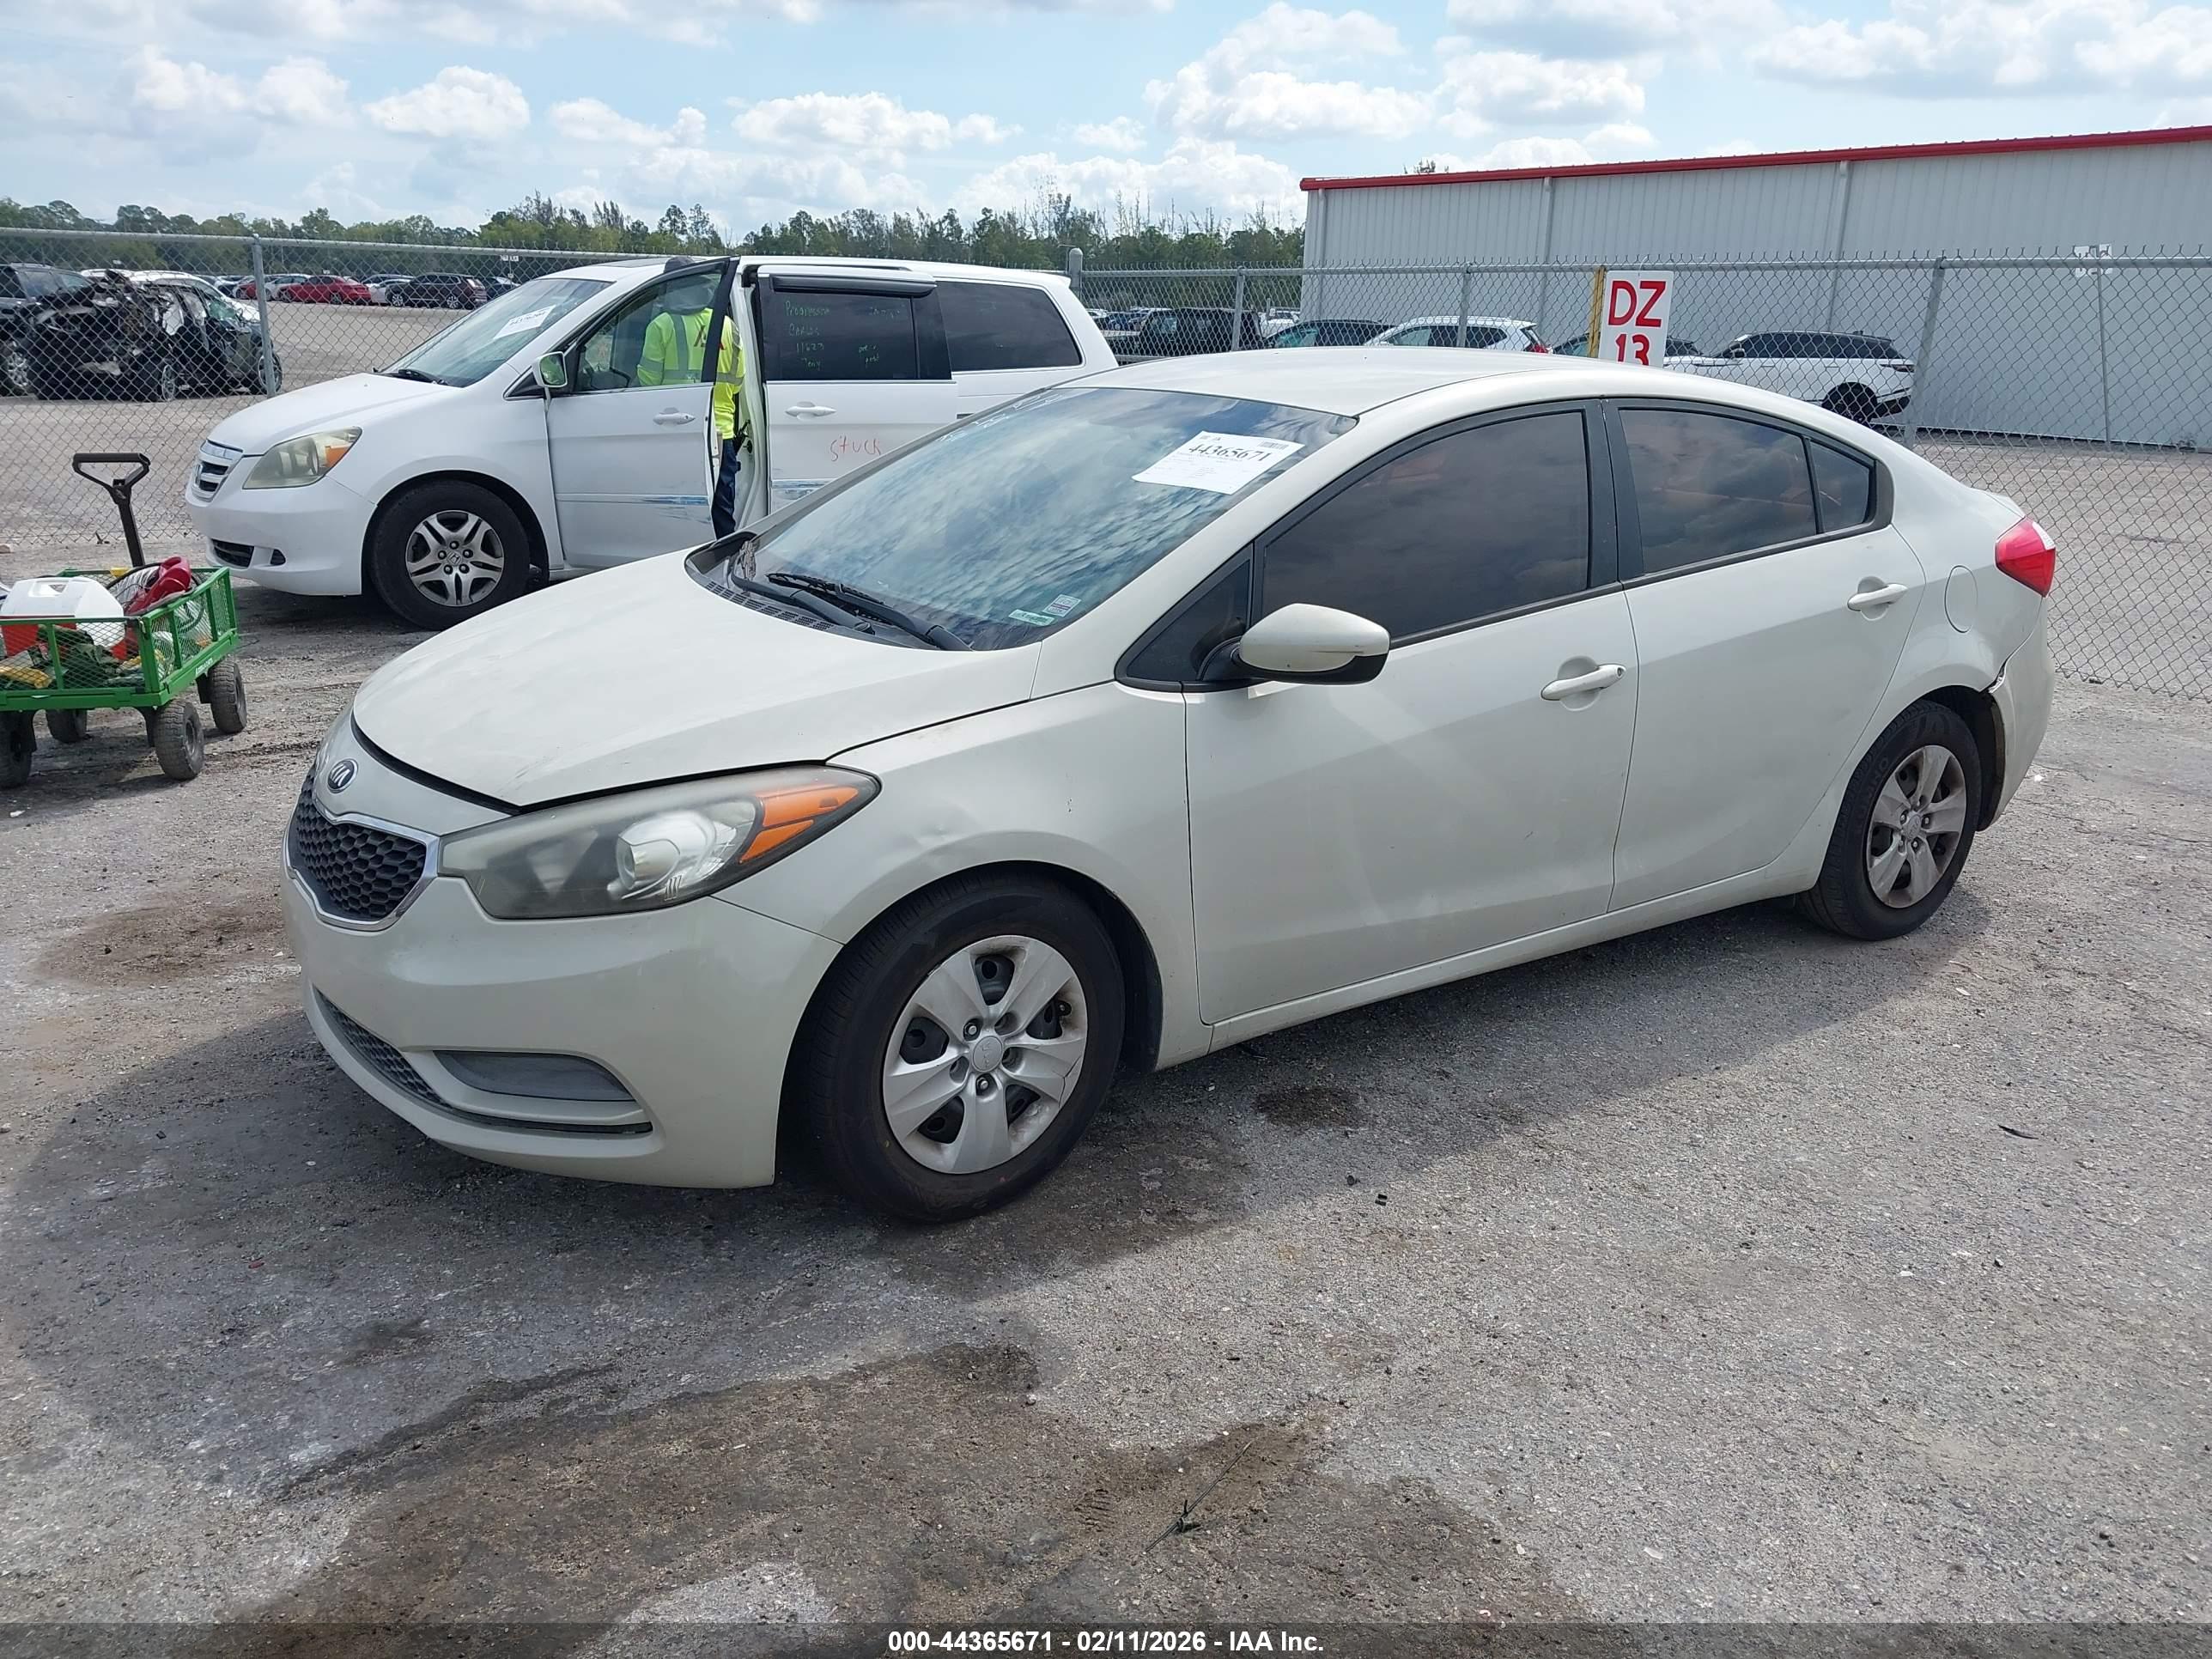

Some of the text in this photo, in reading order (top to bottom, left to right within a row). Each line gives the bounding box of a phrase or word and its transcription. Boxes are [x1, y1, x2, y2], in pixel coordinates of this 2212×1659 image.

[1607, 280, 1667, 328] DZ
[1614, 333, 1650, 367] 13
[1188, 443, 1273, 461] 44365671
